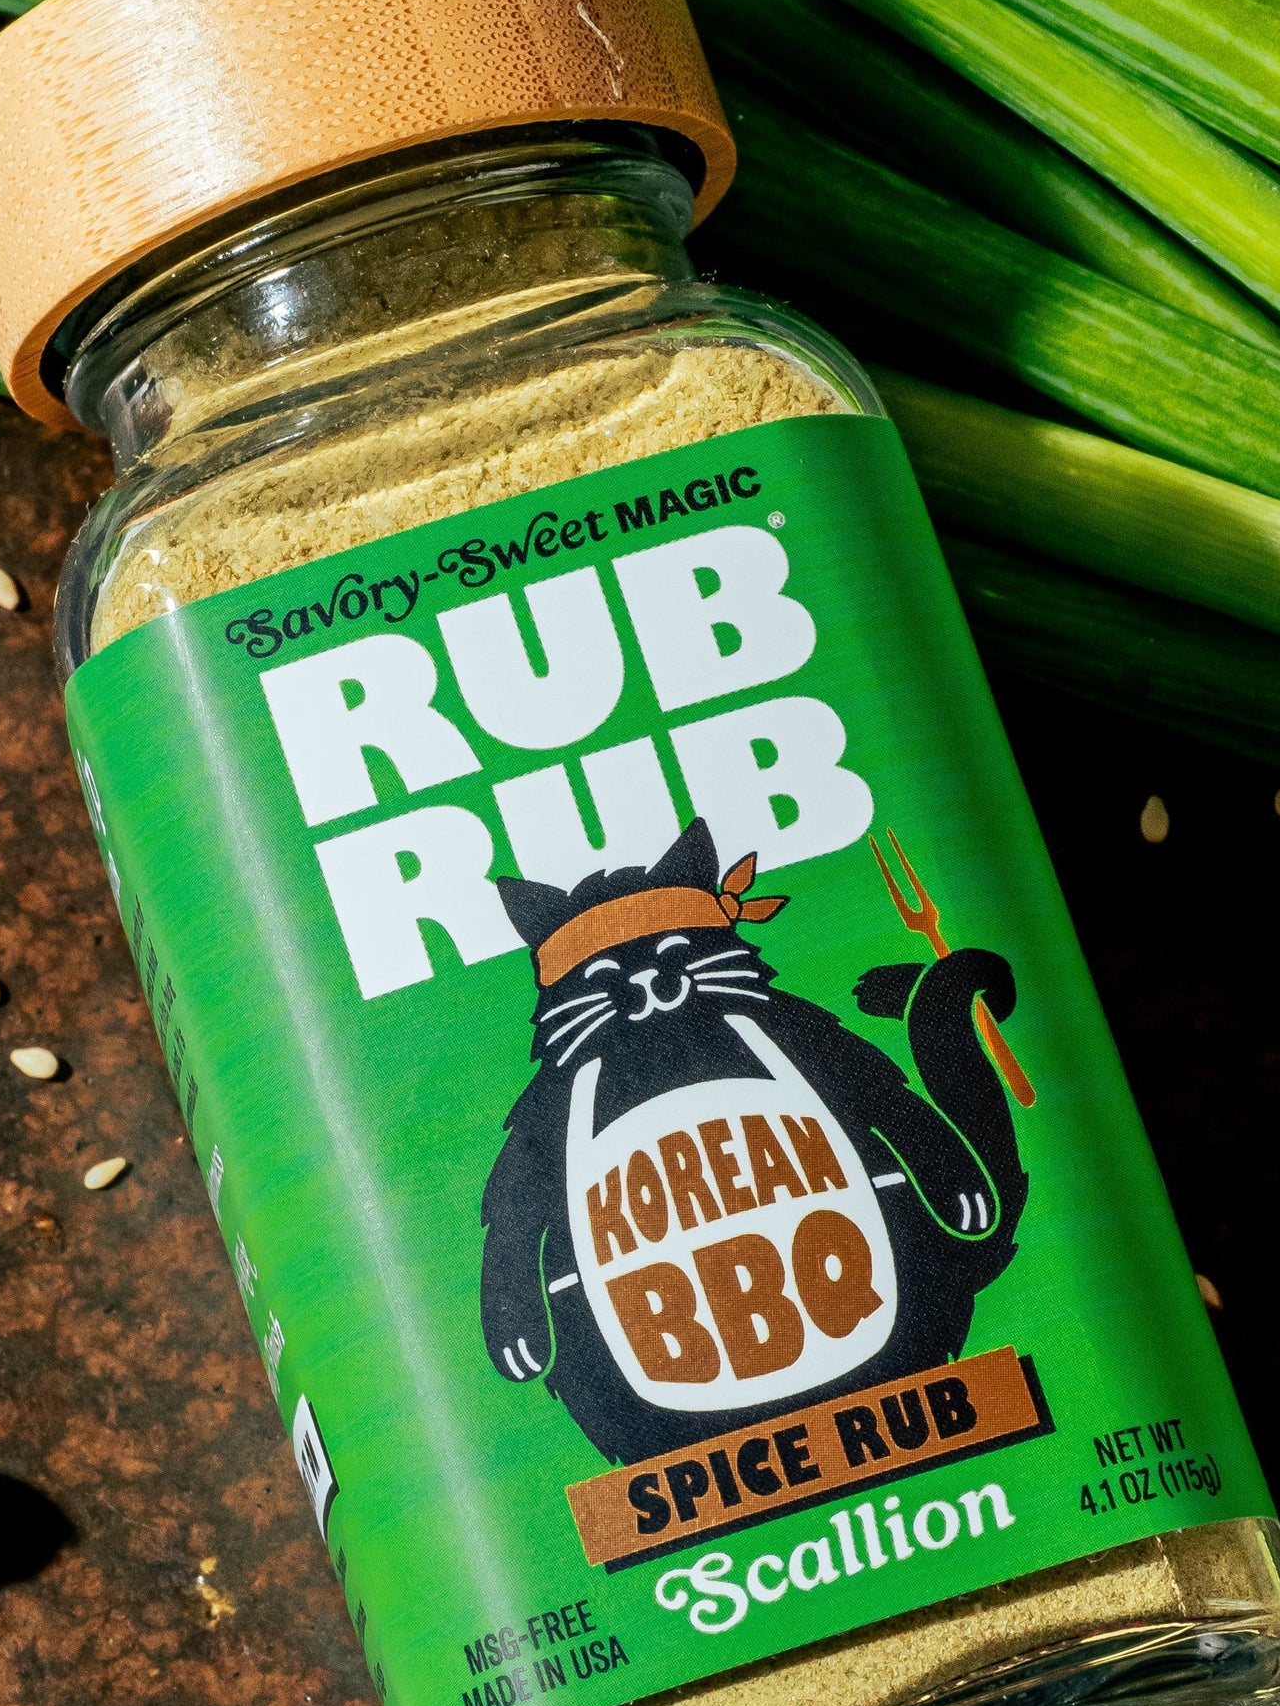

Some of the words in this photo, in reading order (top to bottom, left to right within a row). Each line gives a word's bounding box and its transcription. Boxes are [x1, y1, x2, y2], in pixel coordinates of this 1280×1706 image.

[225, 510, 608, 659] Savory-Sweet
[613, 466, 762, 533] MAGIC
[259, 525, 817, 828] RUB
[313, 696, 875, 1001] RUB
[586, 1115, 849, 1266] KOREAN
[604, 1209, 884, 1384] BBQ
[627, 1424, 822, 1535] SPICE
[833, 1376, 978, 1469] RUB
[1080, 1479, 1117, 1516] 4.1
[1119, 1467, 1158, 1505] OZ
[1158, 1452, 1222, 1499] (115g)
[1093, 1425, 1145, 1469] NET
[1147, 1418, 1186, 1453] WT
[655, 1482, 1015, 1634] Scallion
[464, 1599, 597, 1676] MSG-FREE
[532, 1654, 567, 1693] IN
[569, 1635, 631, 1680] USA
